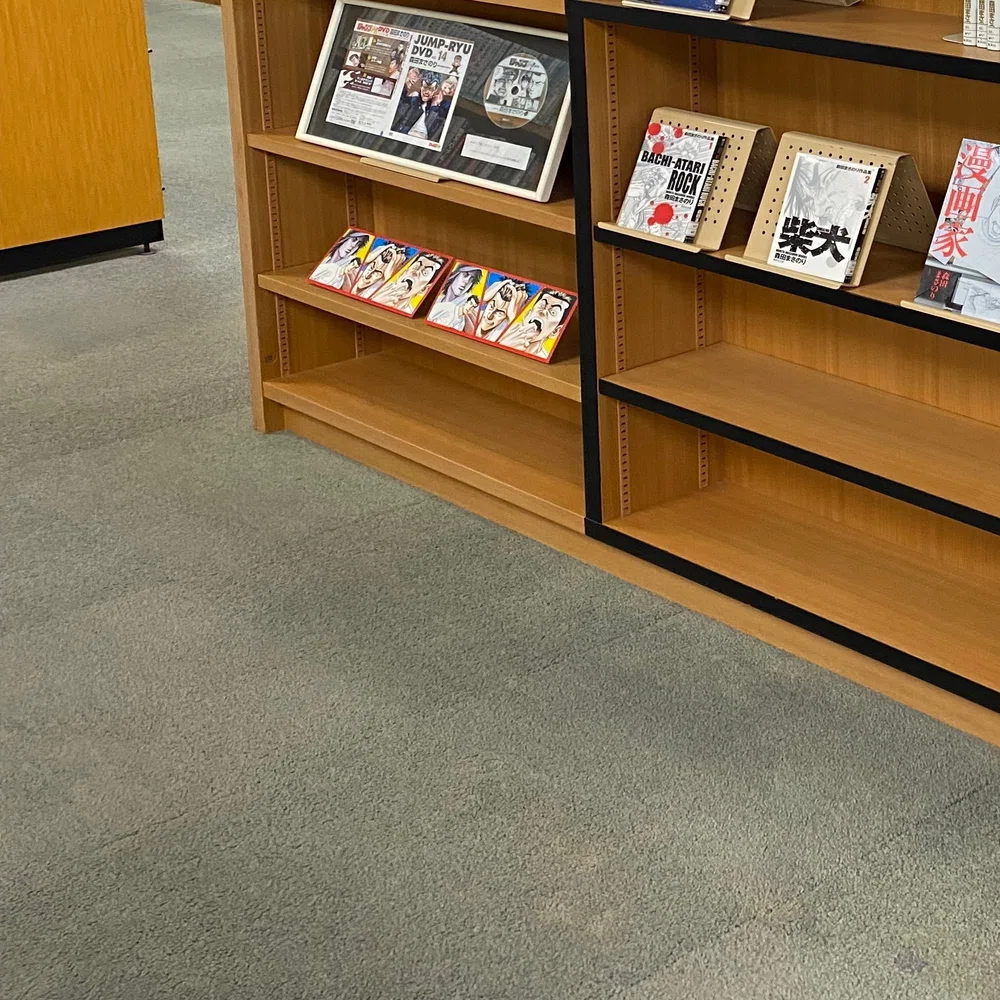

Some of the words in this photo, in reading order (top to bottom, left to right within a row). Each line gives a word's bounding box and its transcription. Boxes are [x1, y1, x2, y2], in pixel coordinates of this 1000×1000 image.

[411, 45, 433, 58] DVD
[438, 50, 447, 62] 14
[413, 34, 472, 55] JUMP-RYU
[641, 150, 706, 175] BACHI-ATARI
[667, 169, 702, 196] ROCK
[933, 143, 995, 258] 漫画家
[778, 216, 851, 264] 柴犬
